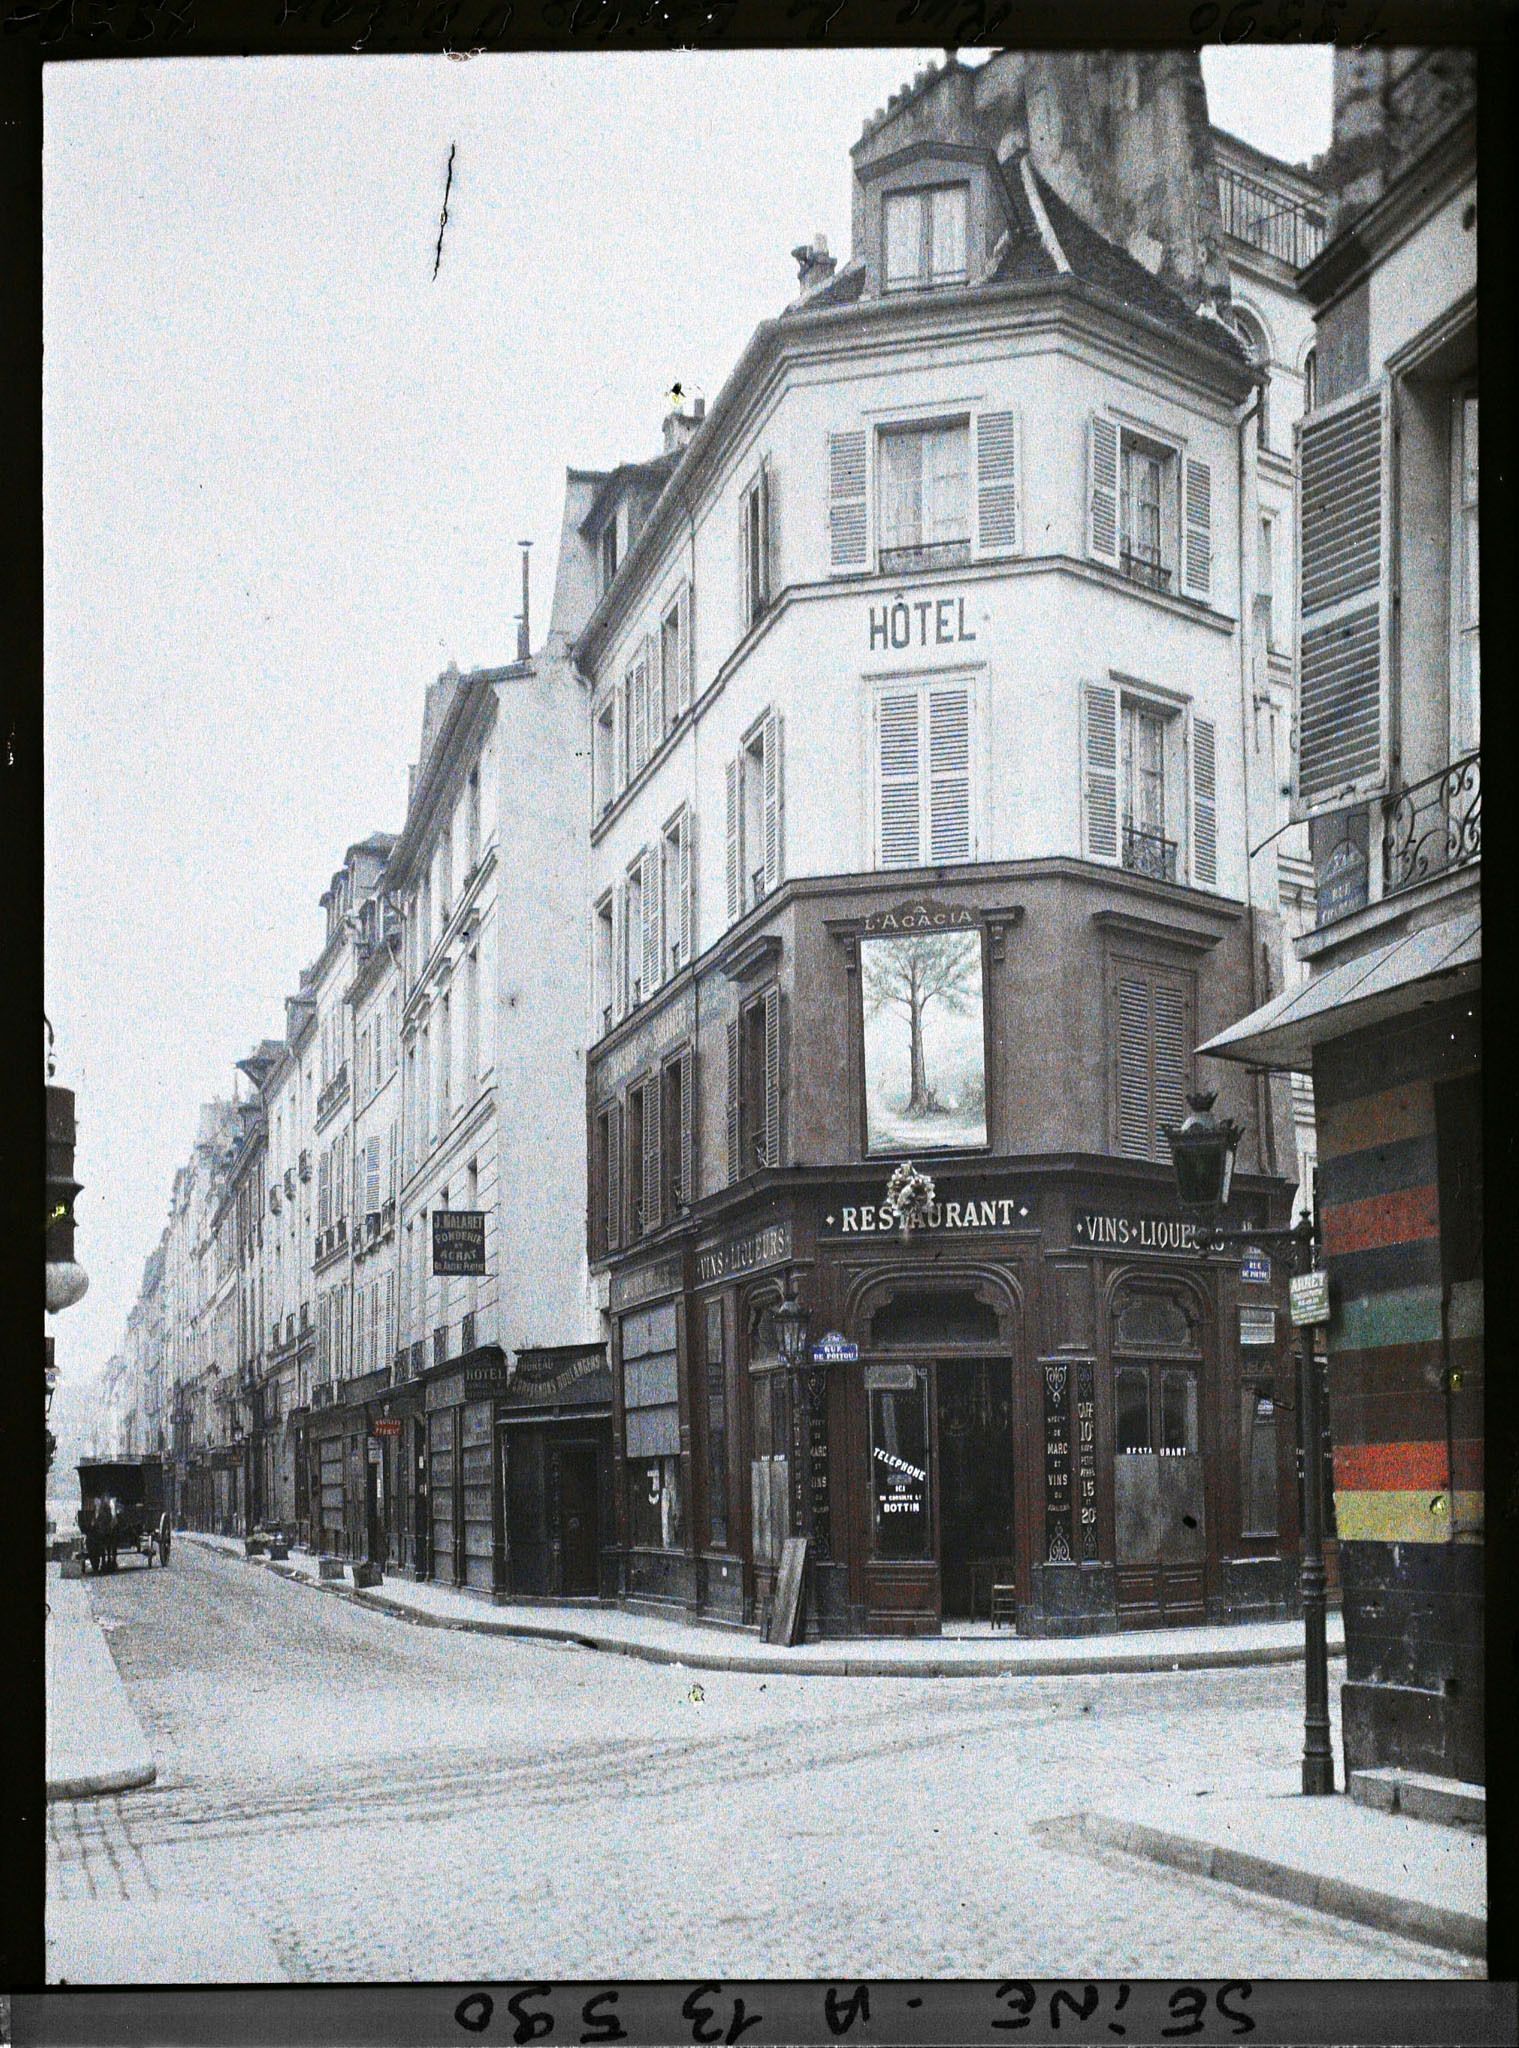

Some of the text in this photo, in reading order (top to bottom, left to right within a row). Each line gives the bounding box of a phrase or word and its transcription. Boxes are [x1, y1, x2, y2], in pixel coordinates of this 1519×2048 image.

[869, 593, 977, 651] HÔTEL
[1085, 1215, 1130, 1244] VINS
[700, 1227, 785, 1280] VINS LIQUEURS
[813, 1352, 854, 1361] DE POITOU
[824, 1345, 843, 1353] RUE
[1047, 1442, 1068, 1455] MARC
[873, 1447, 927, 1482] TELEPHONE
[1047, 1473, 1068, 1486] VINS
[883, 1502, 920, 1513] BOTTIN
[824, 1984, 871, 2036] A
